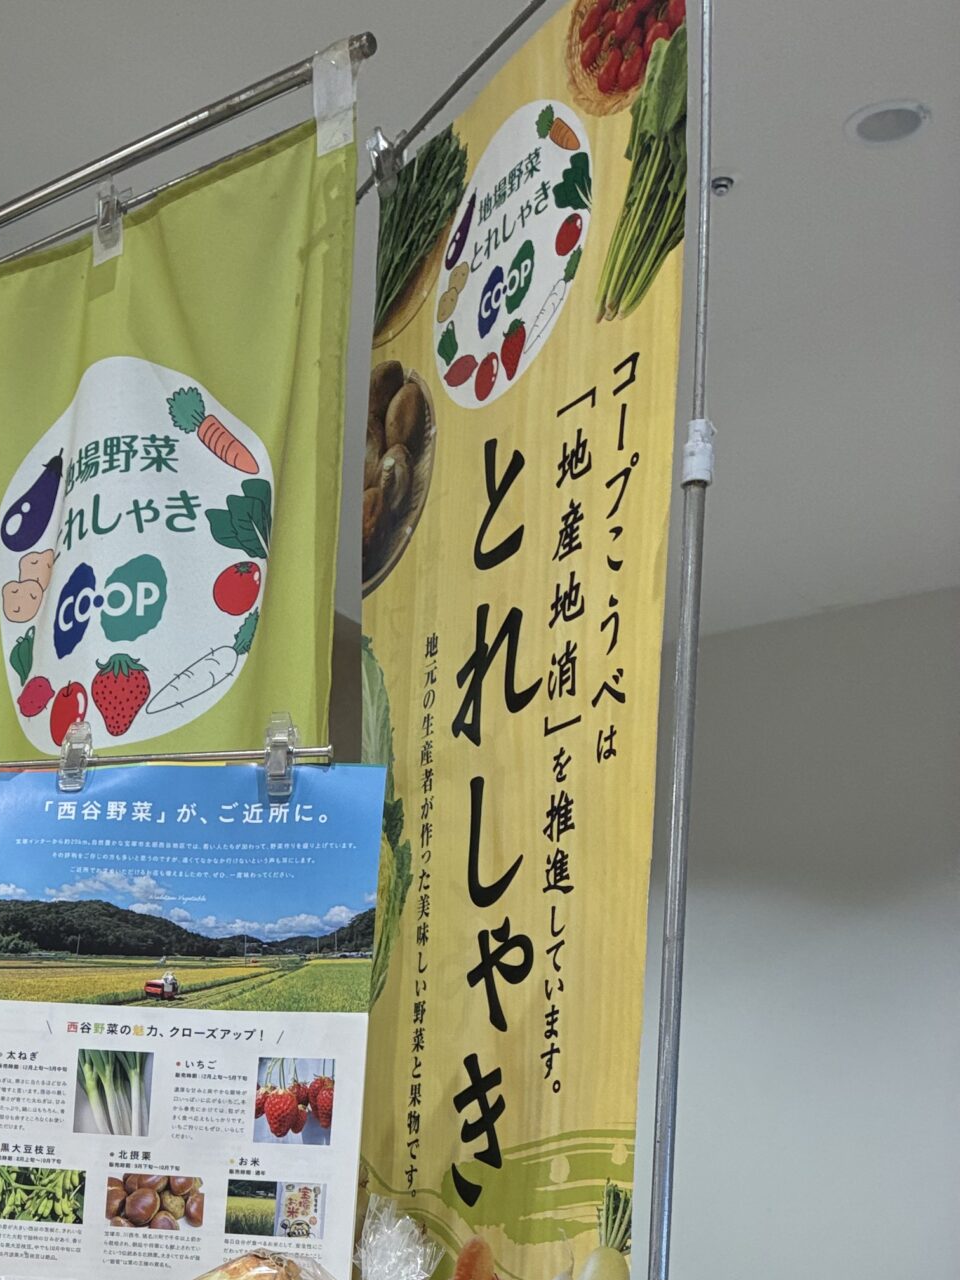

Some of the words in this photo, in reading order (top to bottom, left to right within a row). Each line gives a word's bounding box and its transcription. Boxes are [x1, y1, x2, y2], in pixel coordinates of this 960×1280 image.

[477, 146, 542, 227] 地場野菜
[56, 489, 203, 552] れしゃき
[589, 350, 641, 764] コープこうべは
[539, 385, 597, 1095] 「地産地消」を推進しています。
[42, 801, 330, 825] 「西谷野菜」が、ご近所に。
[404, 631, 439, 1199] 地元の生産者が作った美味しい野菜と果物です。
[6, 1050, 39, 1061] 太ねぎ
[185, 1060, 217, 1070] いちご
[0, 1142, 56, 1156] 黒大豆枝豆
[118, 1149, 152, 1161] 北摂栗
[238, 1157, 260, 1167] お米
